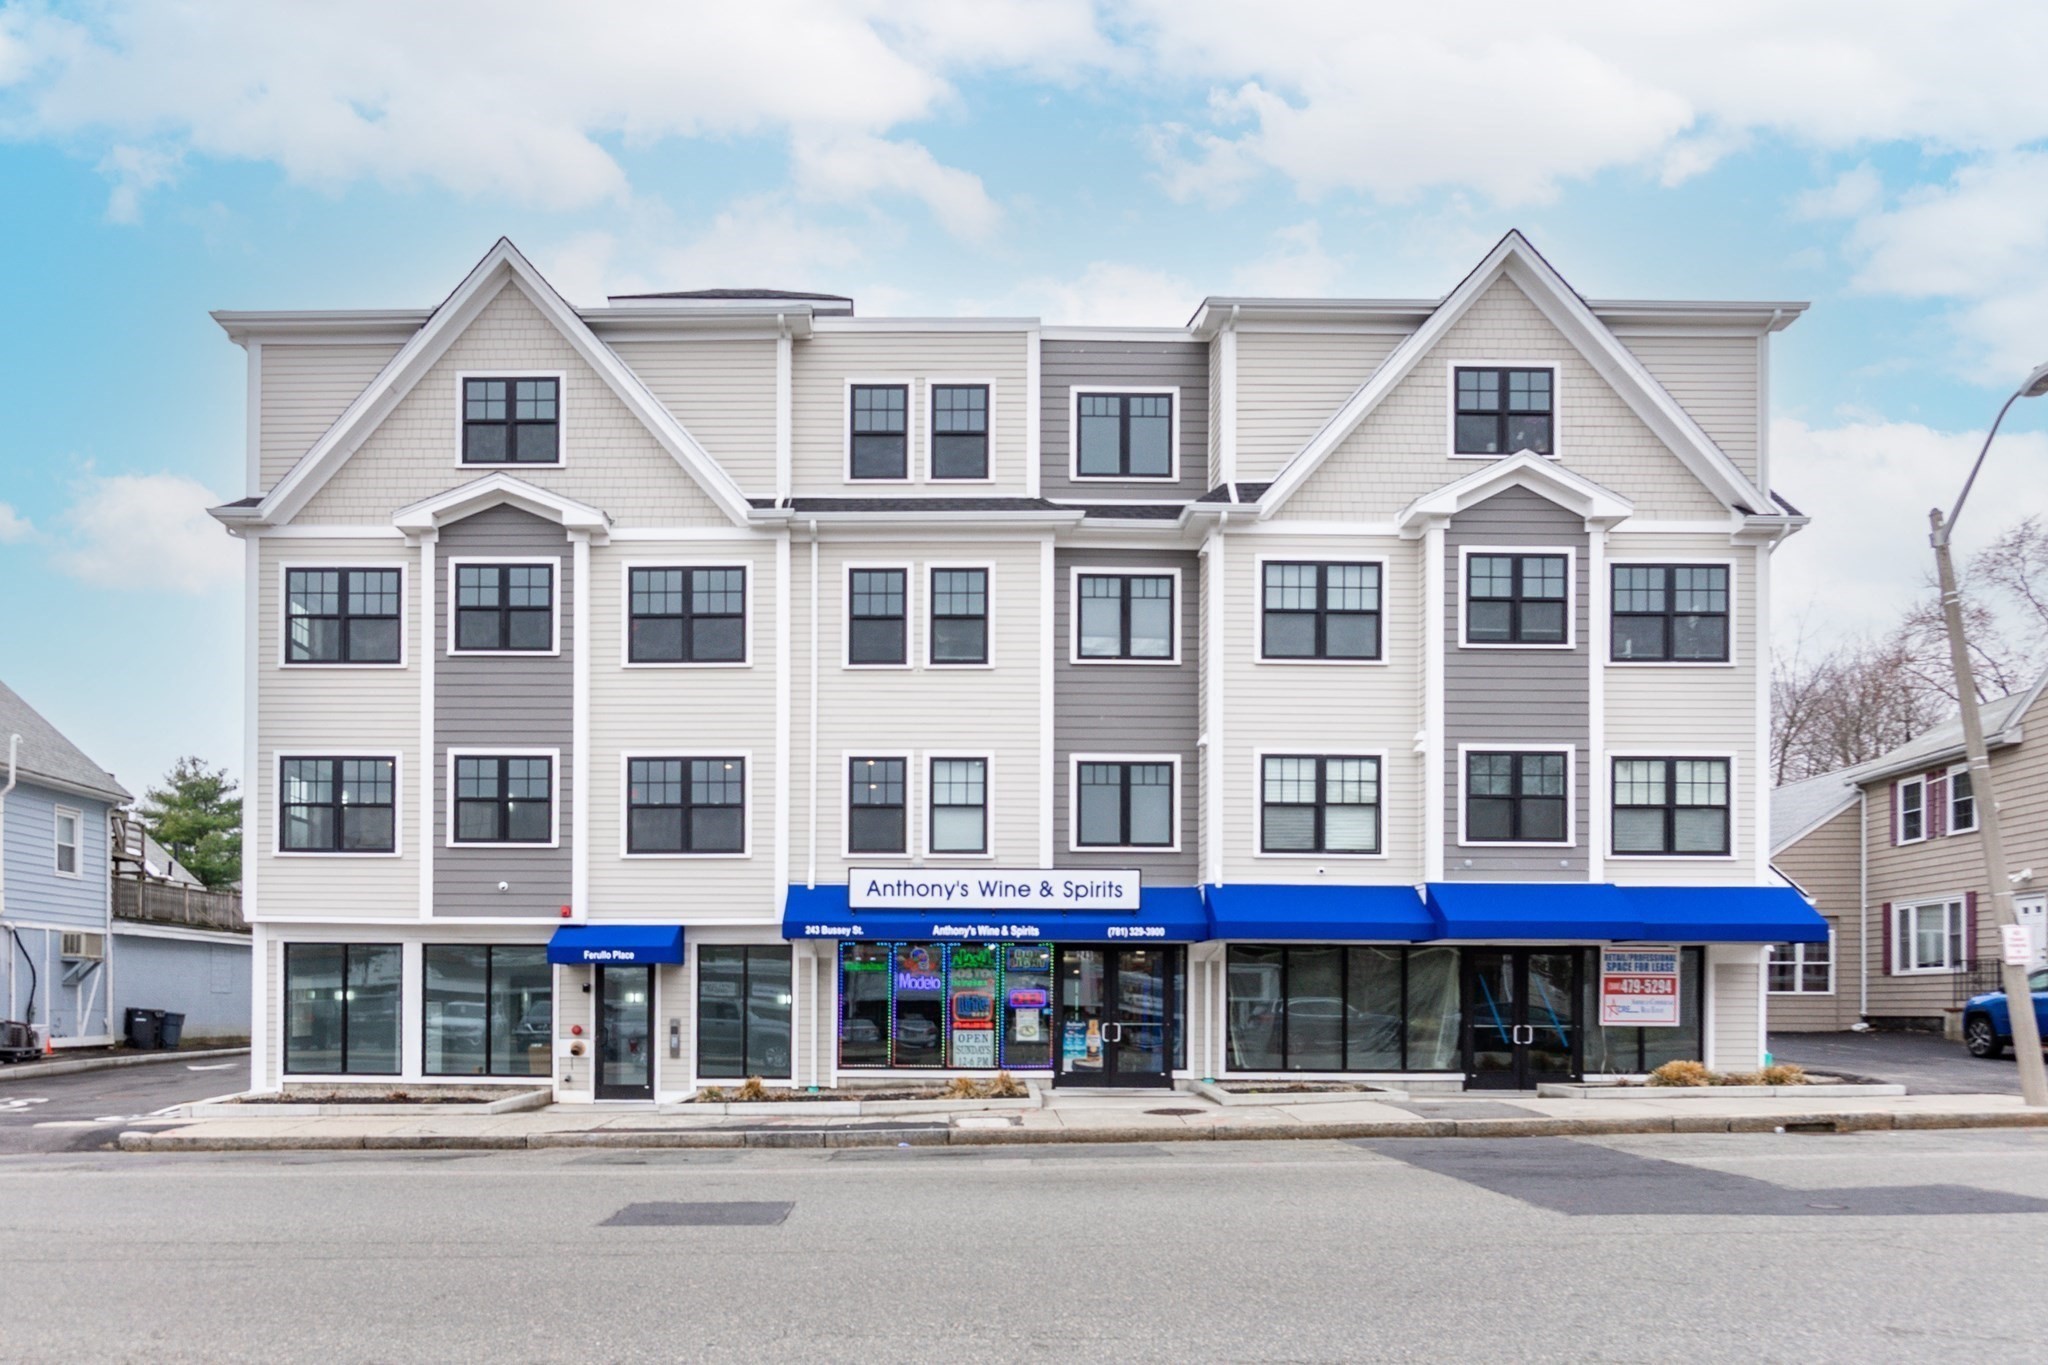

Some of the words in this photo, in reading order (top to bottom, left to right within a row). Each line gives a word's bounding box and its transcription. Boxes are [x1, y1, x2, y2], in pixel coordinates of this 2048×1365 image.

[866, 879, 969, 901] Anthony's
[978, 880, 1031, 898] Wine
[1039, 880, 1055, 898] &
[1063, 880, 1124, 901] Spirits
[805, 925, 820, 935] 243
[821, 925, 851, 937] Bussey
[852, 925, 864, 935] St.
[932, 924, 977, 938] Anthony's
[977, 925, 1000, 936] Wine
[1001, 925, 1009, 936] &
[1010, 925, 1040, 938] Spirits
[1107, 926, 1128, 938] (781)
[583, 950, 612, 960] Ferullo
[612, 950, 635, 960] Place
[1606, 962, 1632, 972] SPACE
[1634, 962, 1650, 972] FOR
[1652, 962, 1674, 972] LEASE
[899, 972, 941, 990] Modelo
[1621, 979, 1672, 993] 479-5294
[958, 1033, 989, 1043] OPEN
[956, 1045, 991, 1055] SUNDAYS
[977, 1056, 989, 1066] PM
